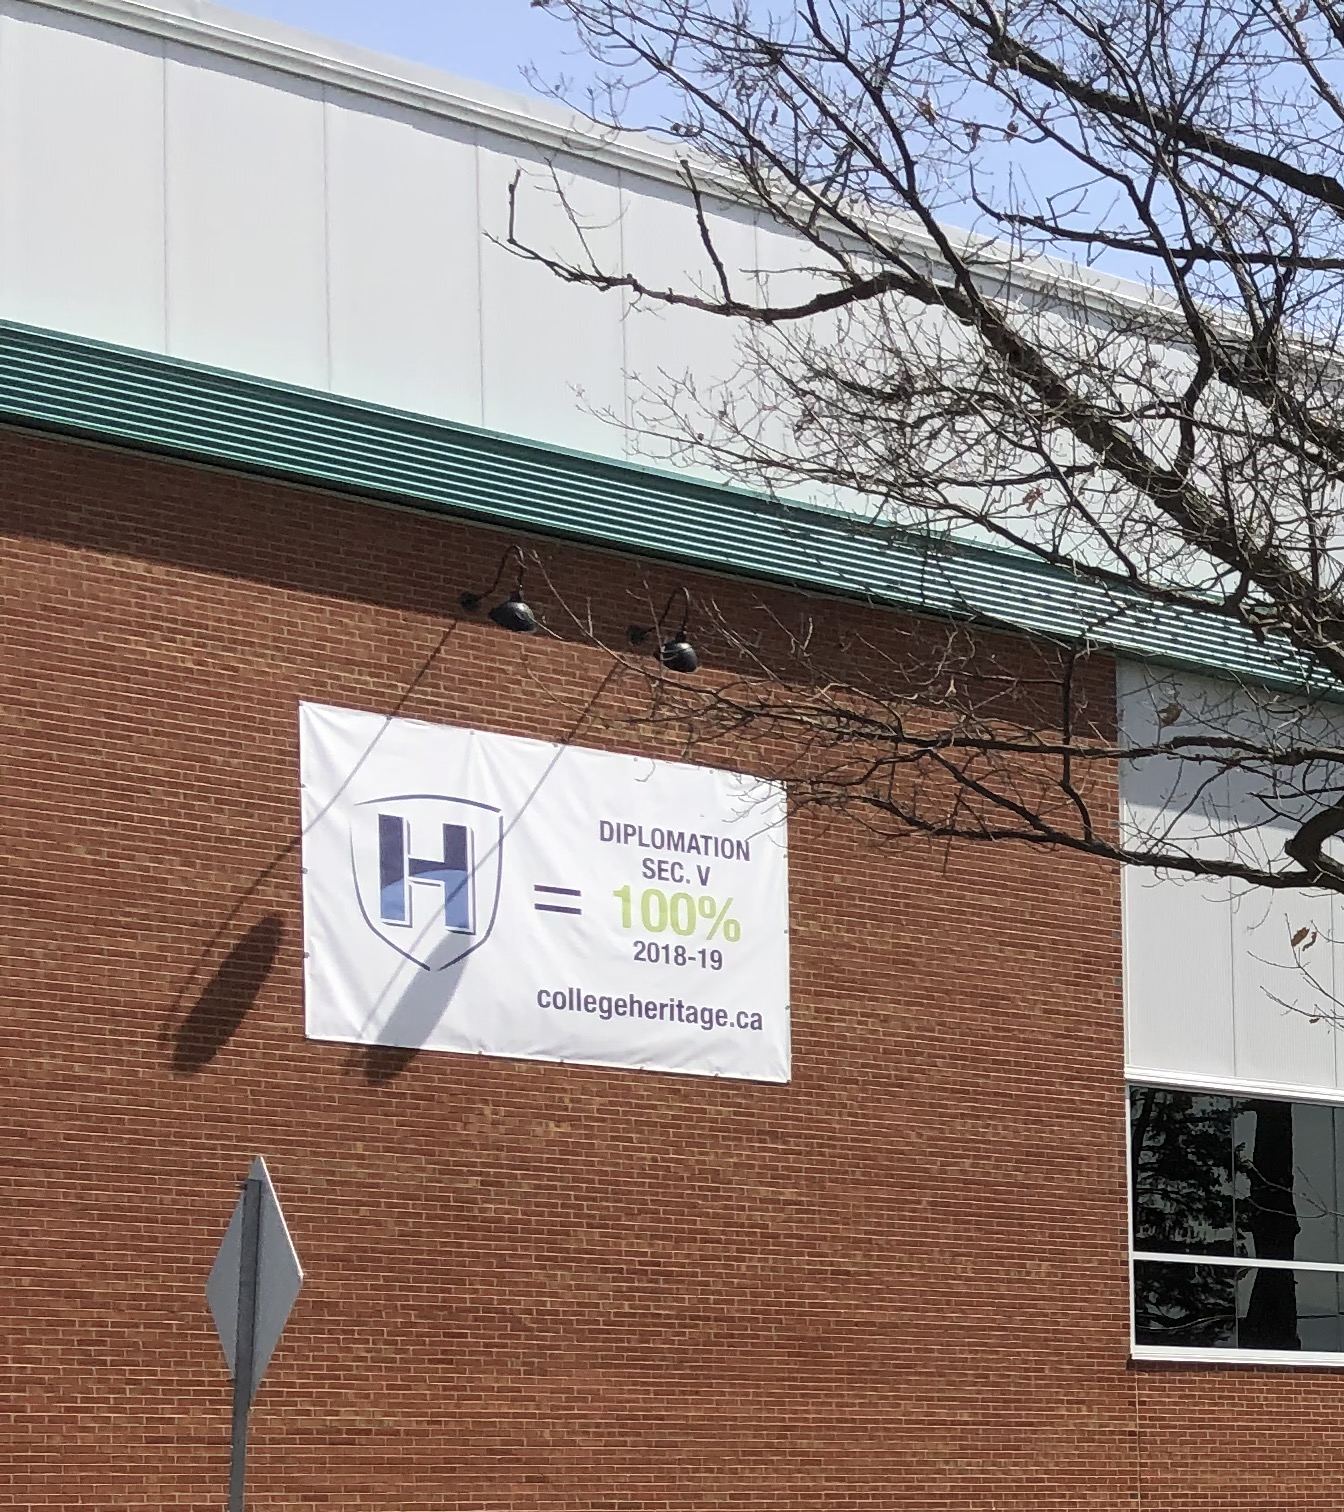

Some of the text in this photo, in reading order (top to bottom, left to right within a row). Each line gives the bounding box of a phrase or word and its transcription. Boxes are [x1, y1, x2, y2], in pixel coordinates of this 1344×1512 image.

[599, 820, 750, 862] DIPLOMATION
[377, 813, 476, 935] H
[642, 857, 711, 887] SEC. V
[612, 884, 741, 944] 100%
[633, 940, 724, 972] 2018-19
[536, 987, 764, 1032] collegeheritage.ca
